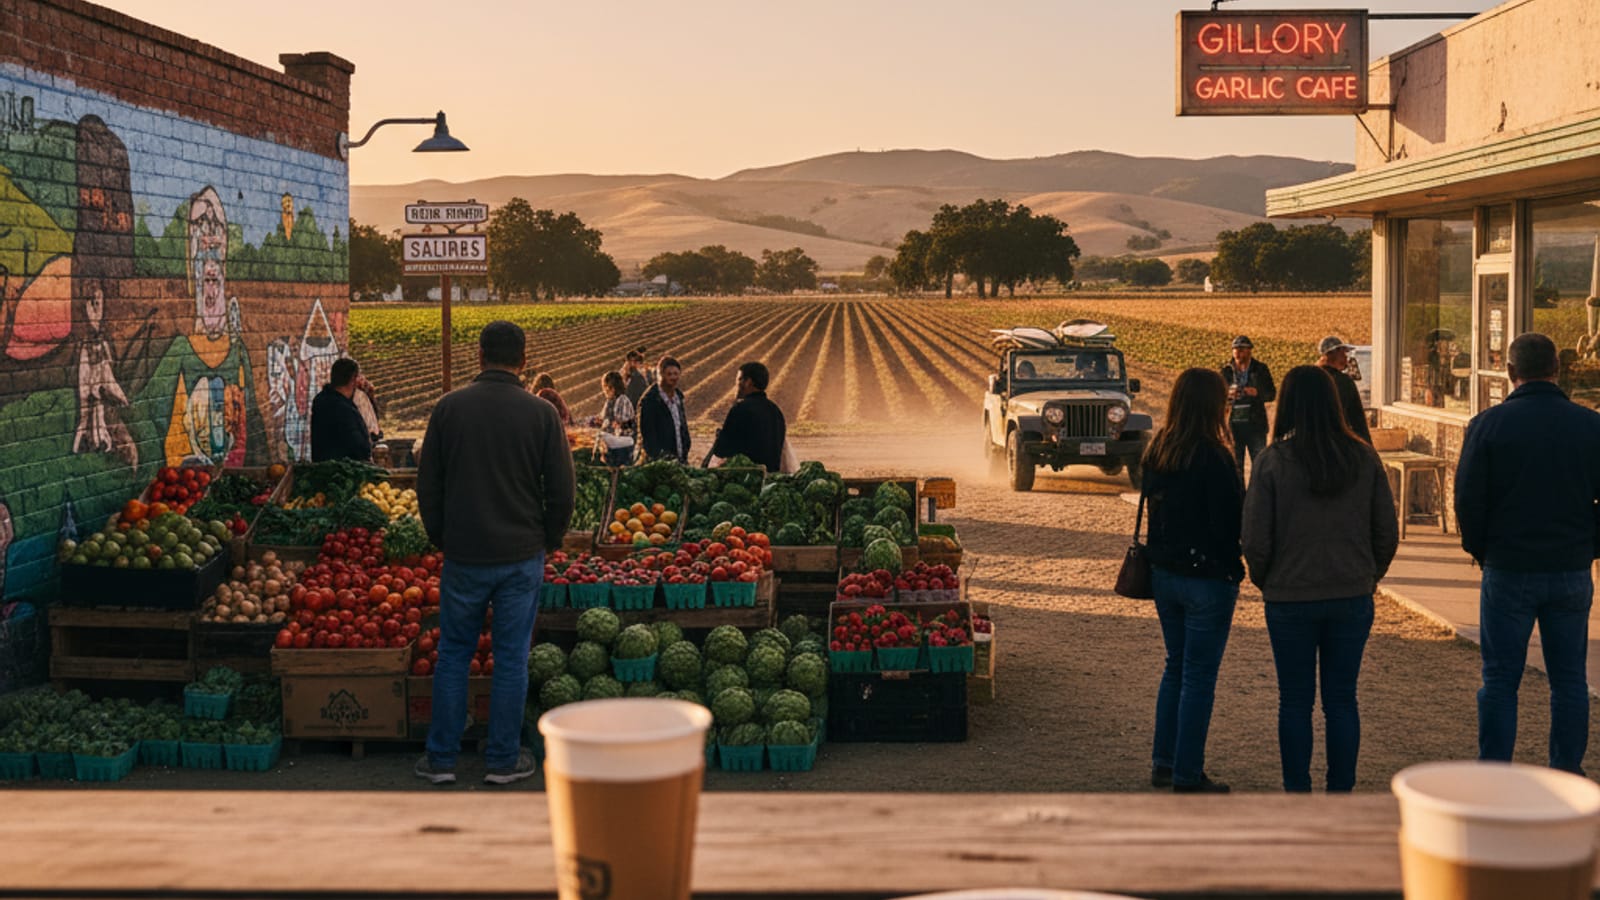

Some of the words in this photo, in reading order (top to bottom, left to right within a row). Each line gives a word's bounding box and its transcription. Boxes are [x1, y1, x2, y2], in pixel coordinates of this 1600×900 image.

[1198, 22, 1347, 54] GILLORY
[1195, 76, 1285, 99] GARLIC
[1296, 76, 1357, 99] CAFE
